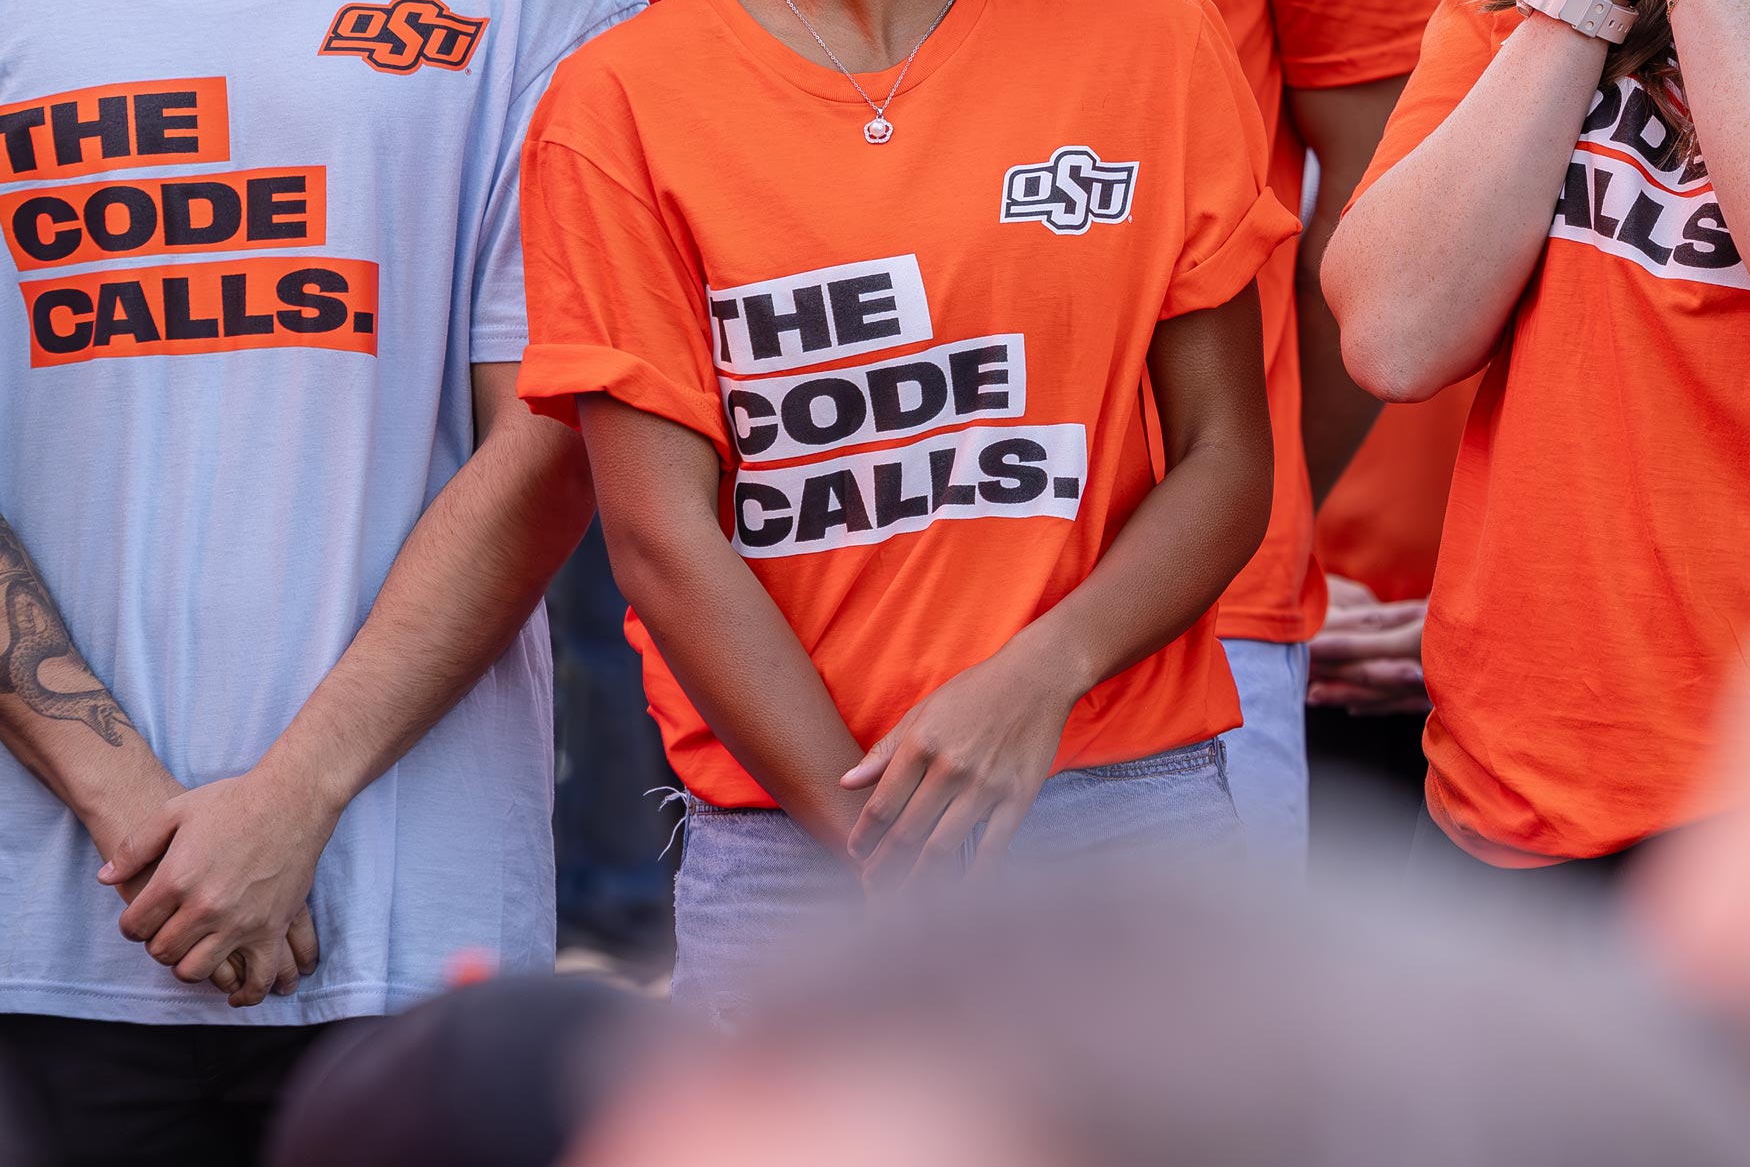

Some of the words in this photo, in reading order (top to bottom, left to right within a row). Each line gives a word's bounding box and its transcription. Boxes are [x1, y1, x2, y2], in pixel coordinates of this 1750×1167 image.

[0, 91, 199, 174] THE
[12, 176, 307, 261] CODE
[1000, 146, 1140, 235] OSU
[1551, 162, 1743, 269] ALLS
[32, 268, 374, 354] CALLS.
[710, 272, 902, 363] THE
[727, 344, 1009, 456] CODE
[735, 438, 1080, 548] CALLS.
